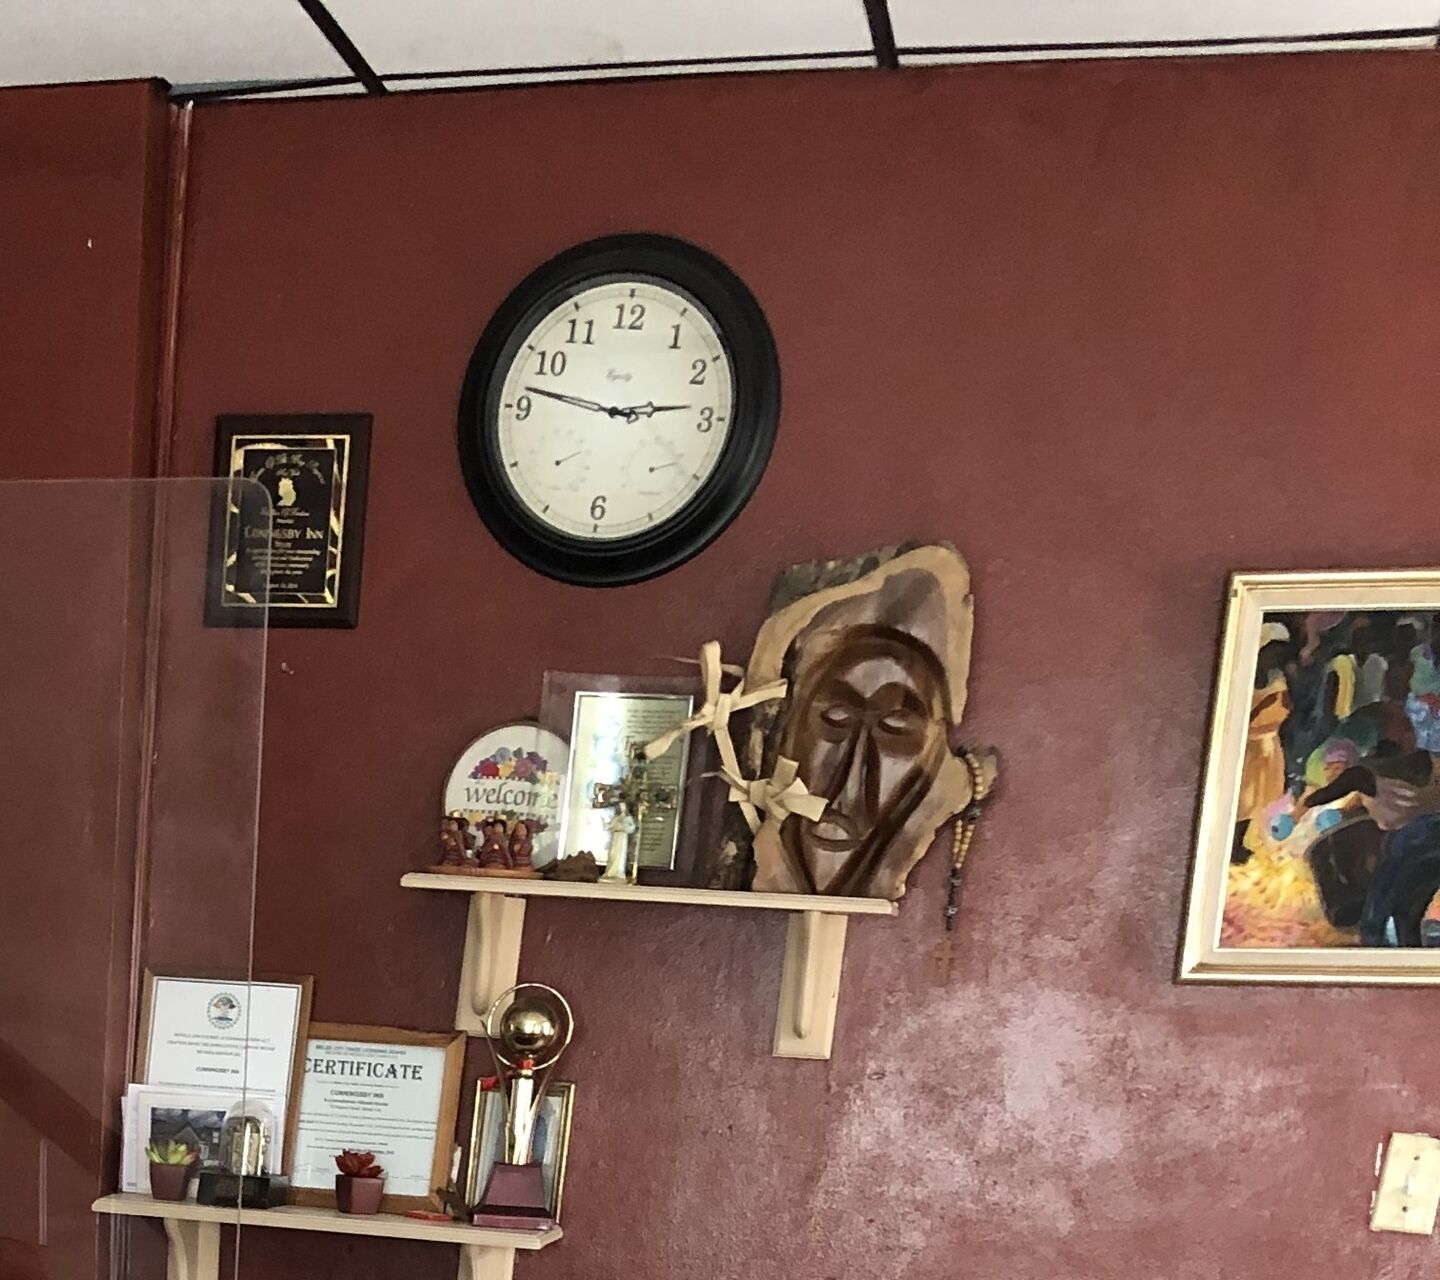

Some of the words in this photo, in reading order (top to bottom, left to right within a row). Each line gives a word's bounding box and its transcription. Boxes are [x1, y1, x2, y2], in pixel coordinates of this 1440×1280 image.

[612, 303, 647, 331] 12
[565, 318, 595, 346] 11
[667, 323, 682, 350] 1
[534, 350, 567, 377] 10
[688, 358, 708, 386] 2
[515, 396, 532, 421] 9
[696, 407, 714, 433] 3
[590, 495, 607, 521] 6
[465, 782, 559, 809] welcome
[304, 1057, 424, 1081] CERTIFICATE
